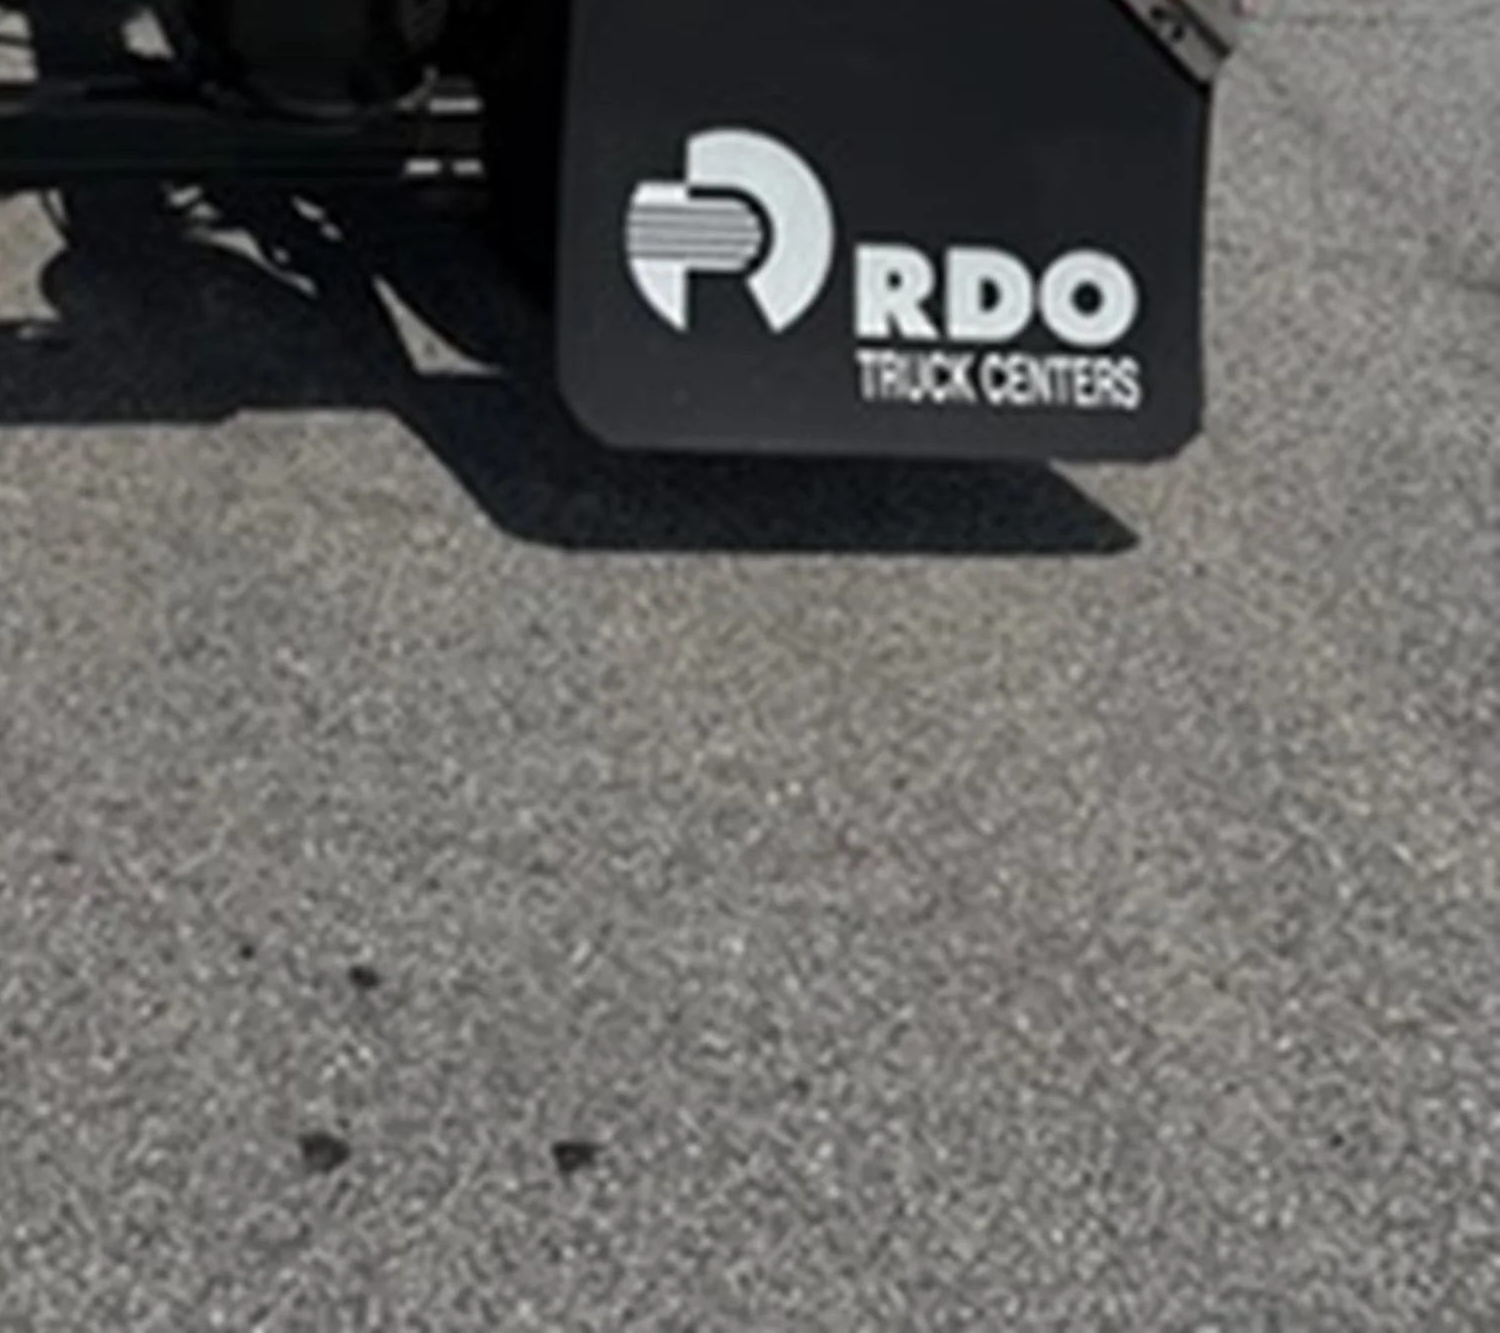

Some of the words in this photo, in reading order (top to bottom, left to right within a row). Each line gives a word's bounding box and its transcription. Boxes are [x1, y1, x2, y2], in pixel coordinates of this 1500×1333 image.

[855, 243, 1139, 347] RDO
[855, 348, 977, 403] TRUCK
[979, 354, 1142, 410] CENTERS
